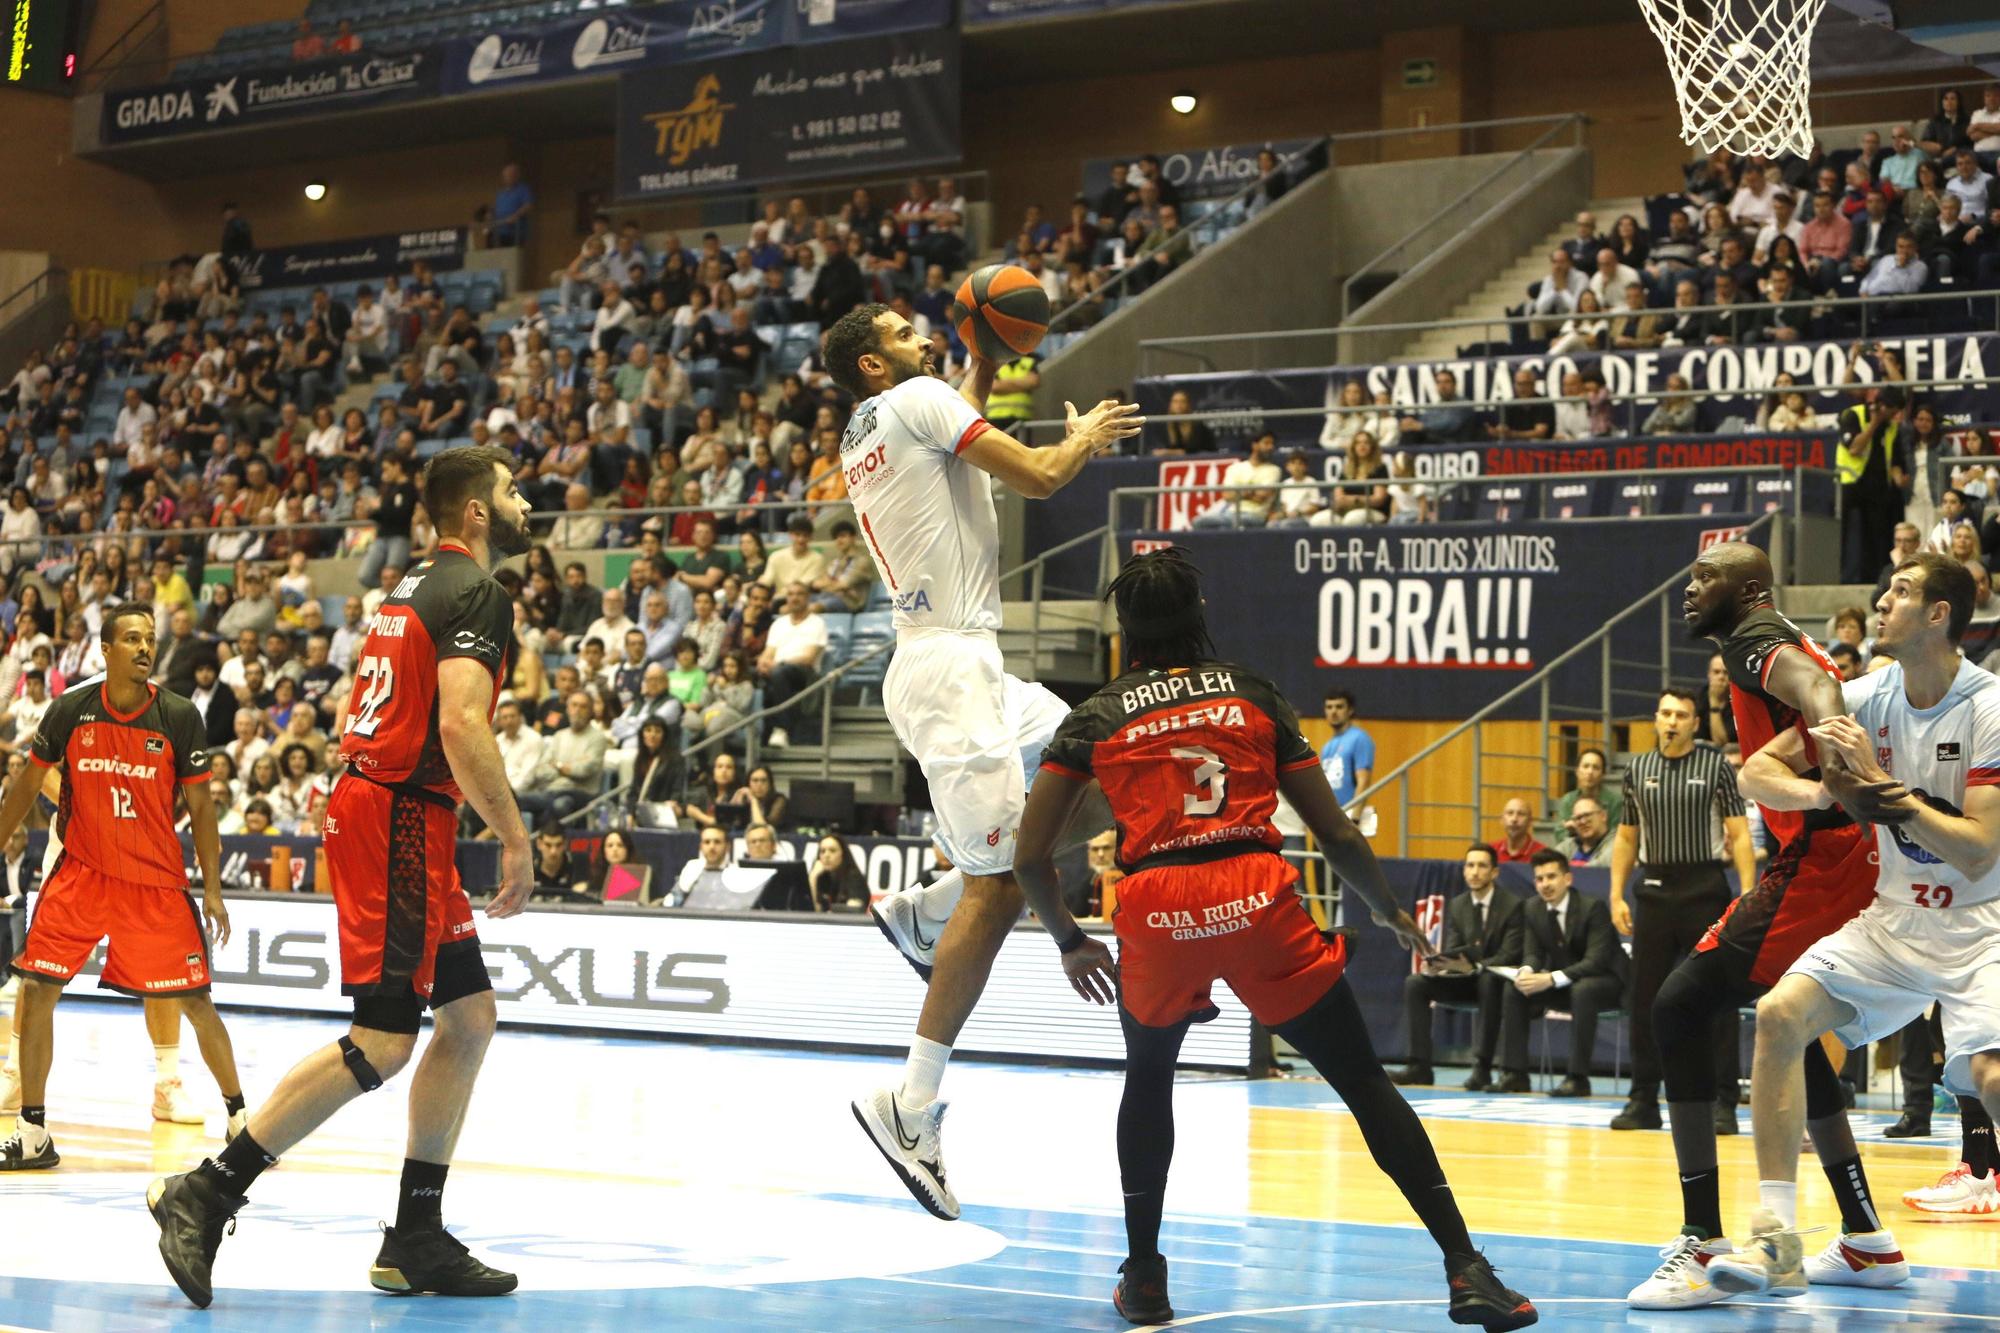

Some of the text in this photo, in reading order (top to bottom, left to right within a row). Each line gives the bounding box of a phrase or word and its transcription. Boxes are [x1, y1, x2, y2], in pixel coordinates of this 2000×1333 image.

[117, 91, 194, 129] GRADA
[247, 70, 336, 104] Fundación
[1197, 143, 1300, 184] Afiar
[1367, 336, 1987, 413] SANTIAGO DE COMPOSELA
[1324, 439, 1825, 483] OOIRO SANTIAGO DE COMPOSTELA
[1693, 481, 1729, 495] OBRA
[1401, 538, 1467, 573] TODOS
[1472, 535, 1559, 574] XUNTOS,
[1318, 577, 1532, 665] OBRA!!!
[1121, 672, 1236, 714] BROPLEH
[80, 713, 96, 722] vive
[1126, 706, 1246, 743] PULEVA
[1170, 746, 1230, 817] 3
[110, 786, 137, 819] 12
[1146, 891, 1275, 929] CAJA RURAL
[1171, 916, 1252, 941] GRANADA
[153, 977, 188, 989] BERNER
[411, 1186, 442, 1198] vive
